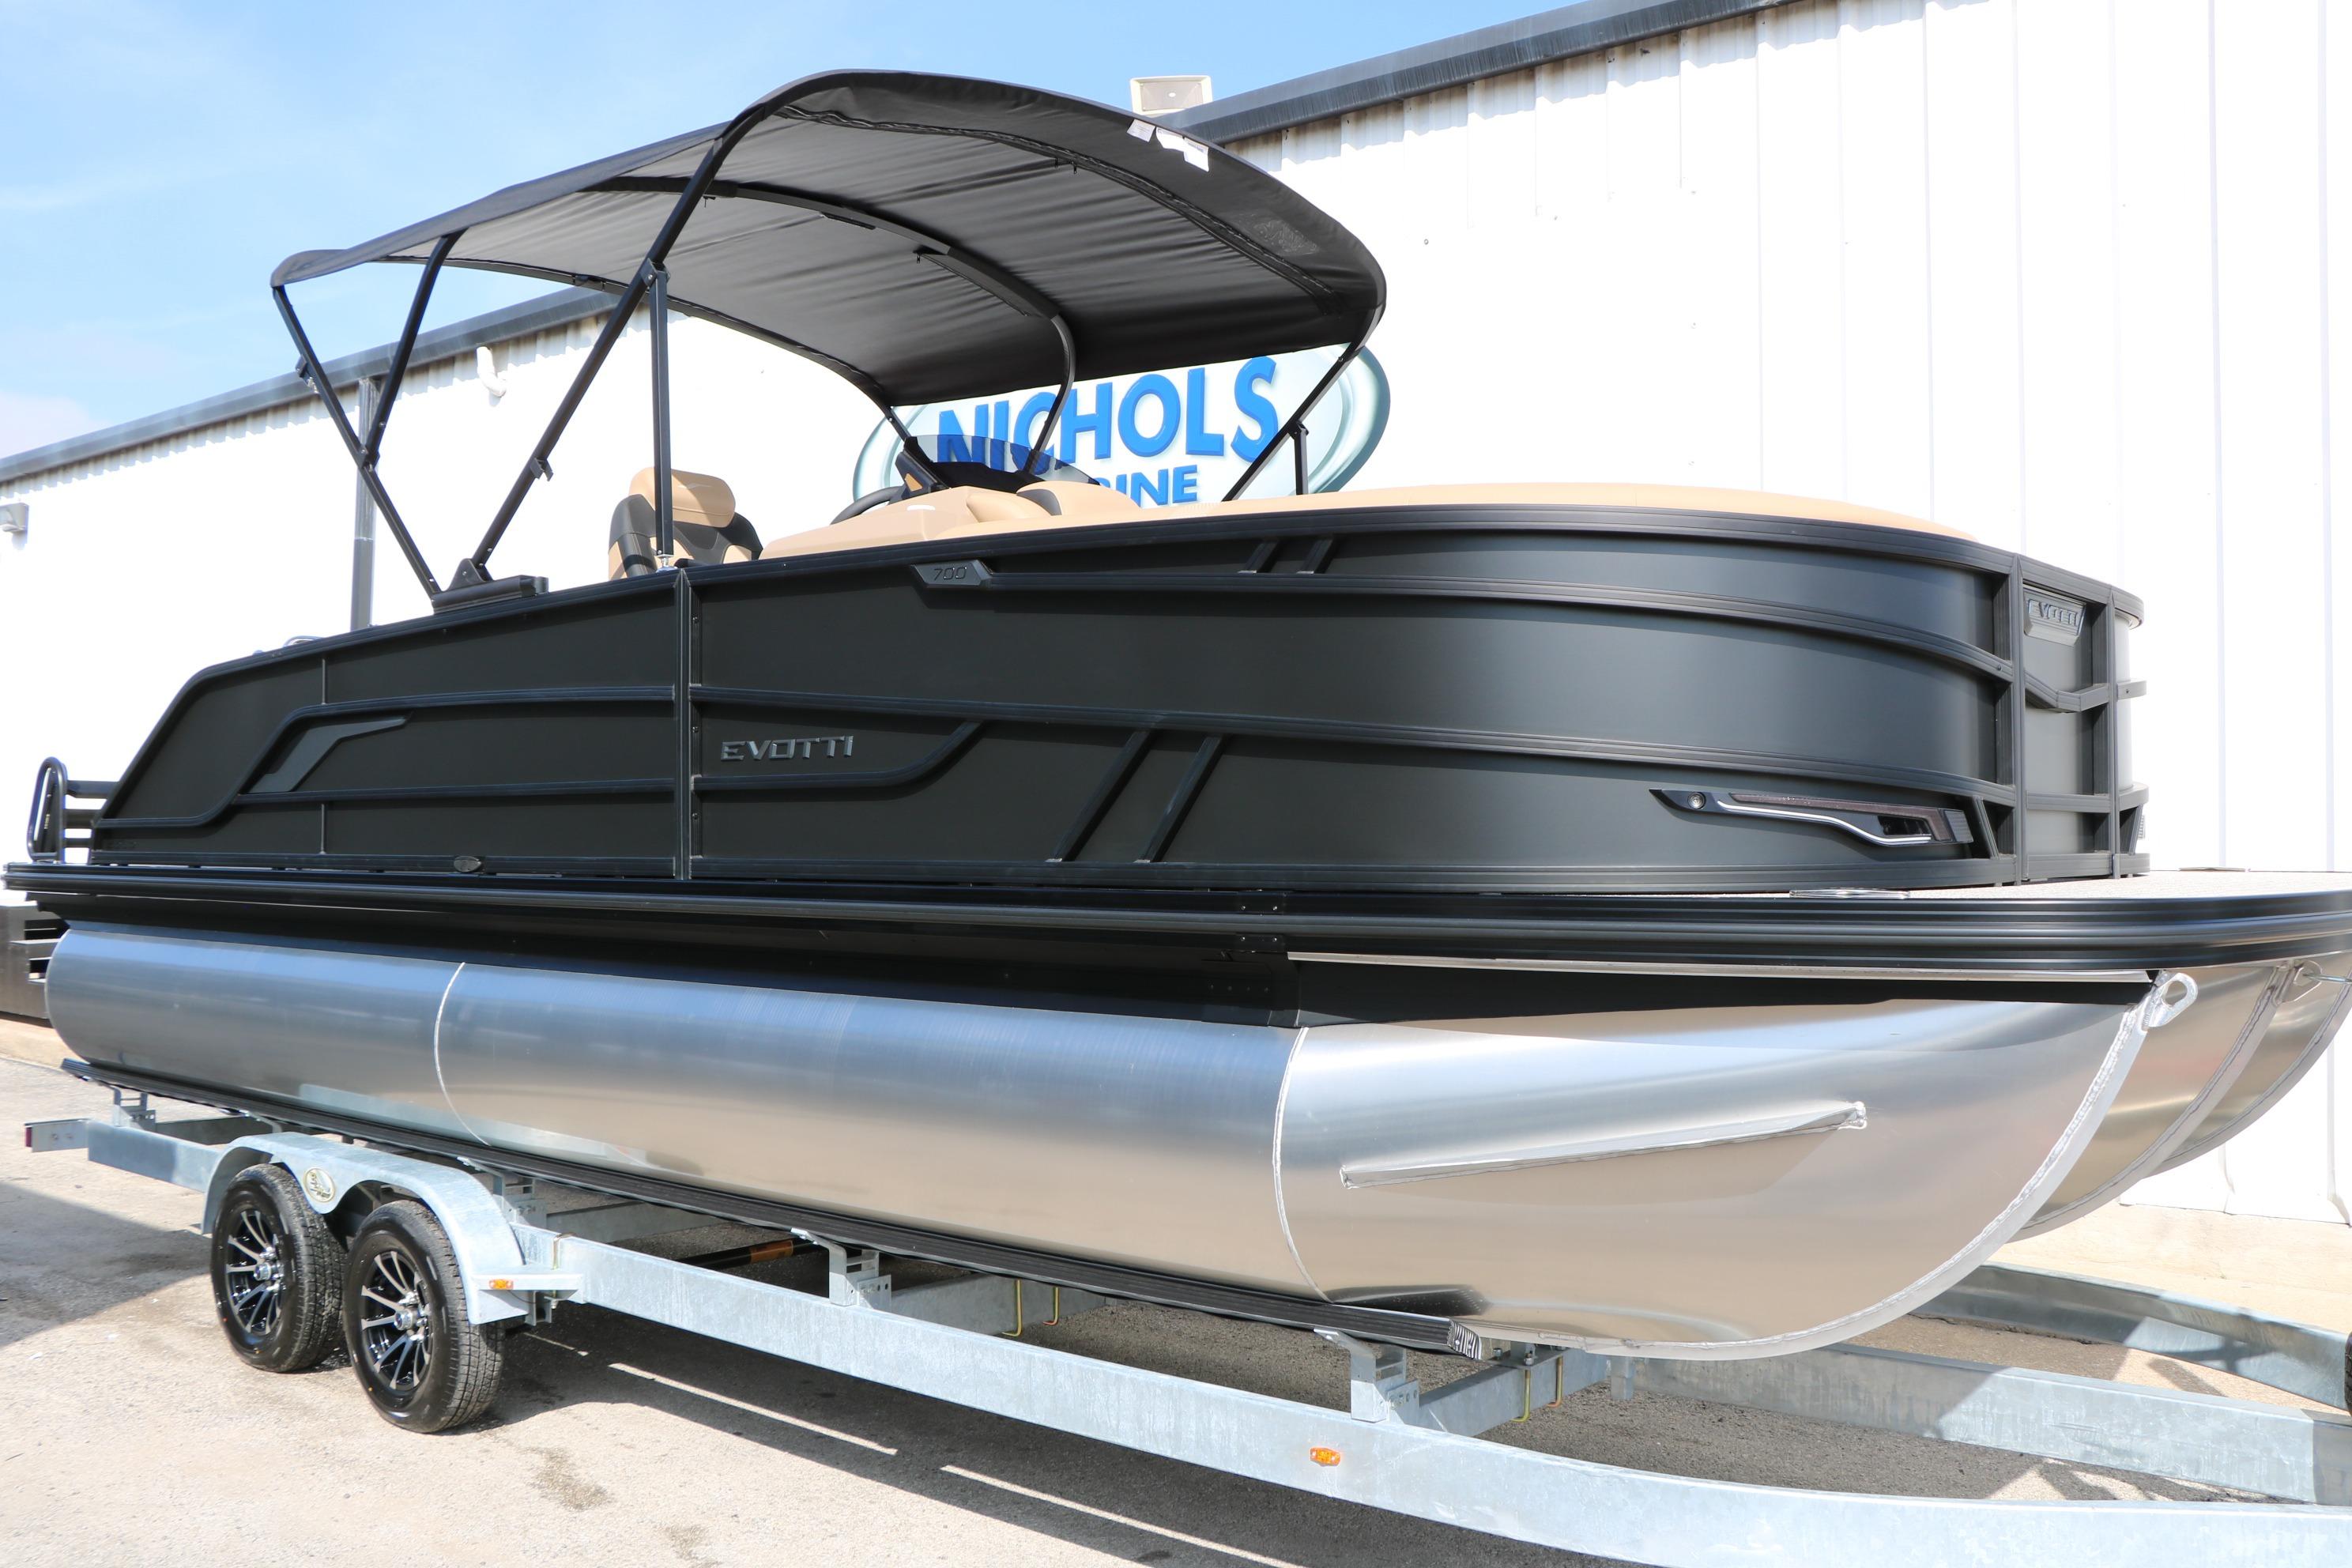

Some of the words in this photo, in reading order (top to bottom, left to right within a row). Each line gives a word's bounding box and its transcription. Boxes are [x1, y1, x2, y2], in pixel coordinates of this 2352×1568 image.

[937, 356, 1279, 475] NICHOLS
[933, 567, 967, 581] 700
[720, 735, 854, 760] EVOTTI
